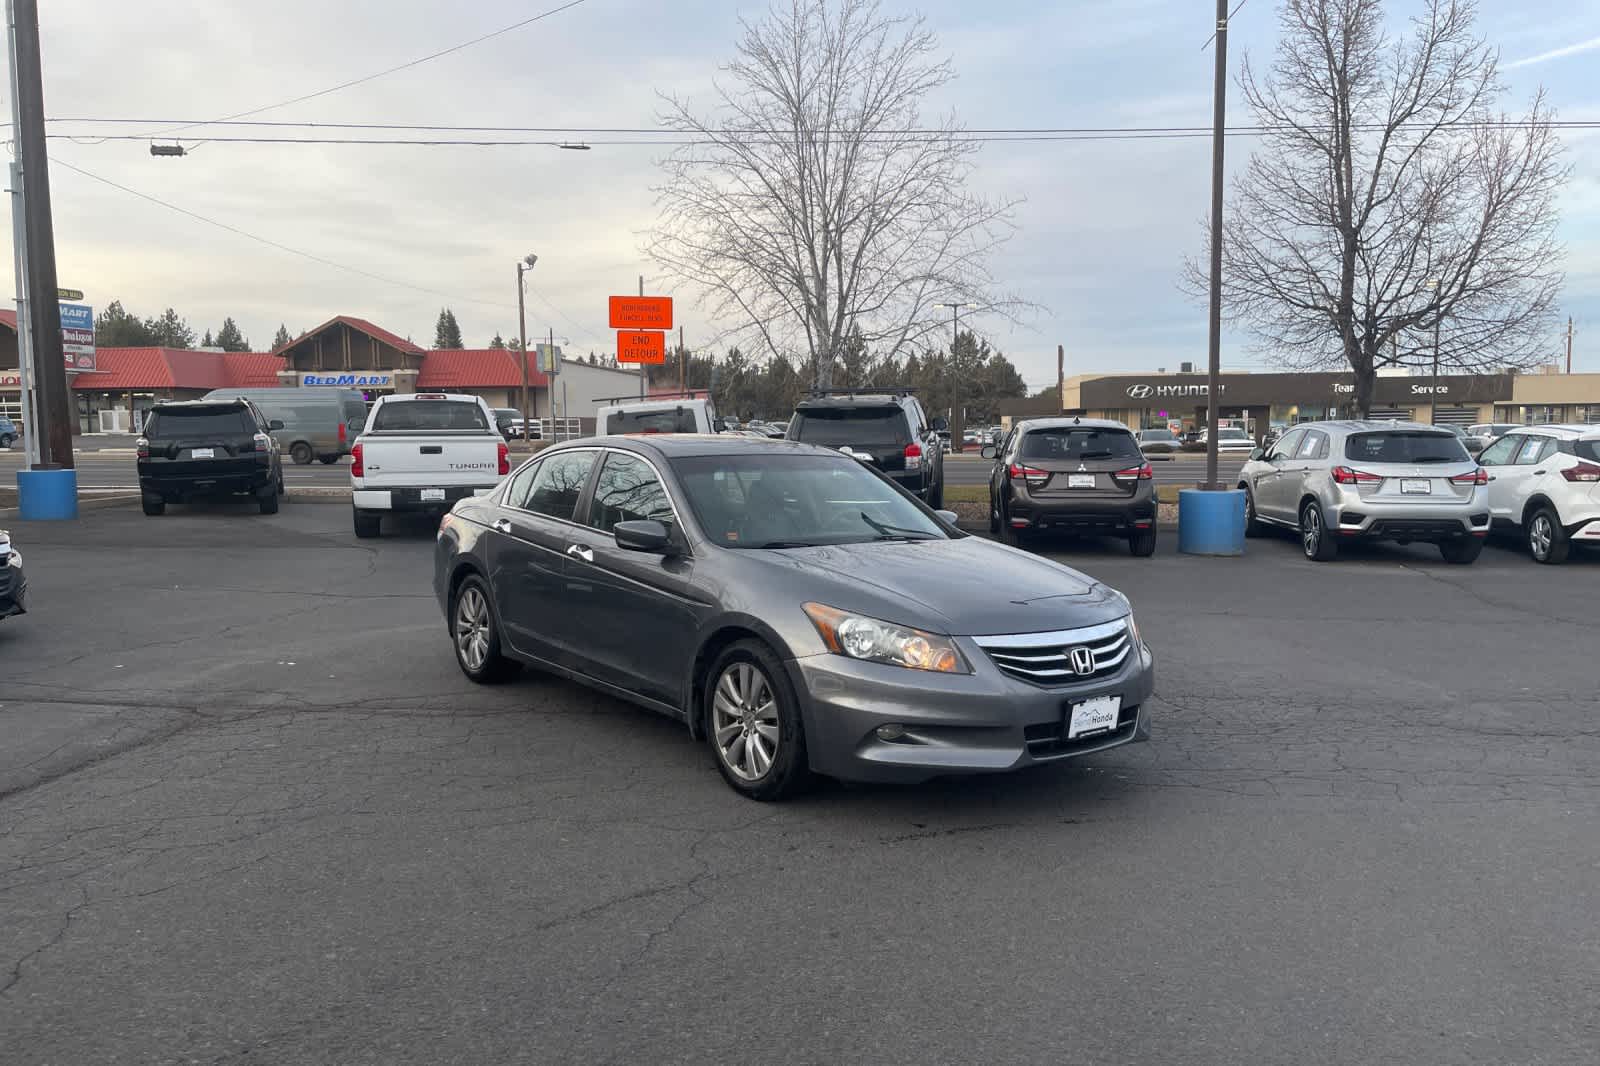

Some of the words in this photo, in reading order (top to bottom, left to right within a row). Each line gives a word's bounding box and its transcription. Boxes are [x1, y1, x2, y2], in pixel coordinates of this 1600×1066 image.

[632, 335, 650, 345] END
[624, 348, 658, 359] DETOUR
[1157, 385, 1225, 396] HYUNDI
[1410, 384, 1448, 394] Servce
[1092, 712, 1113, 724] Honda
